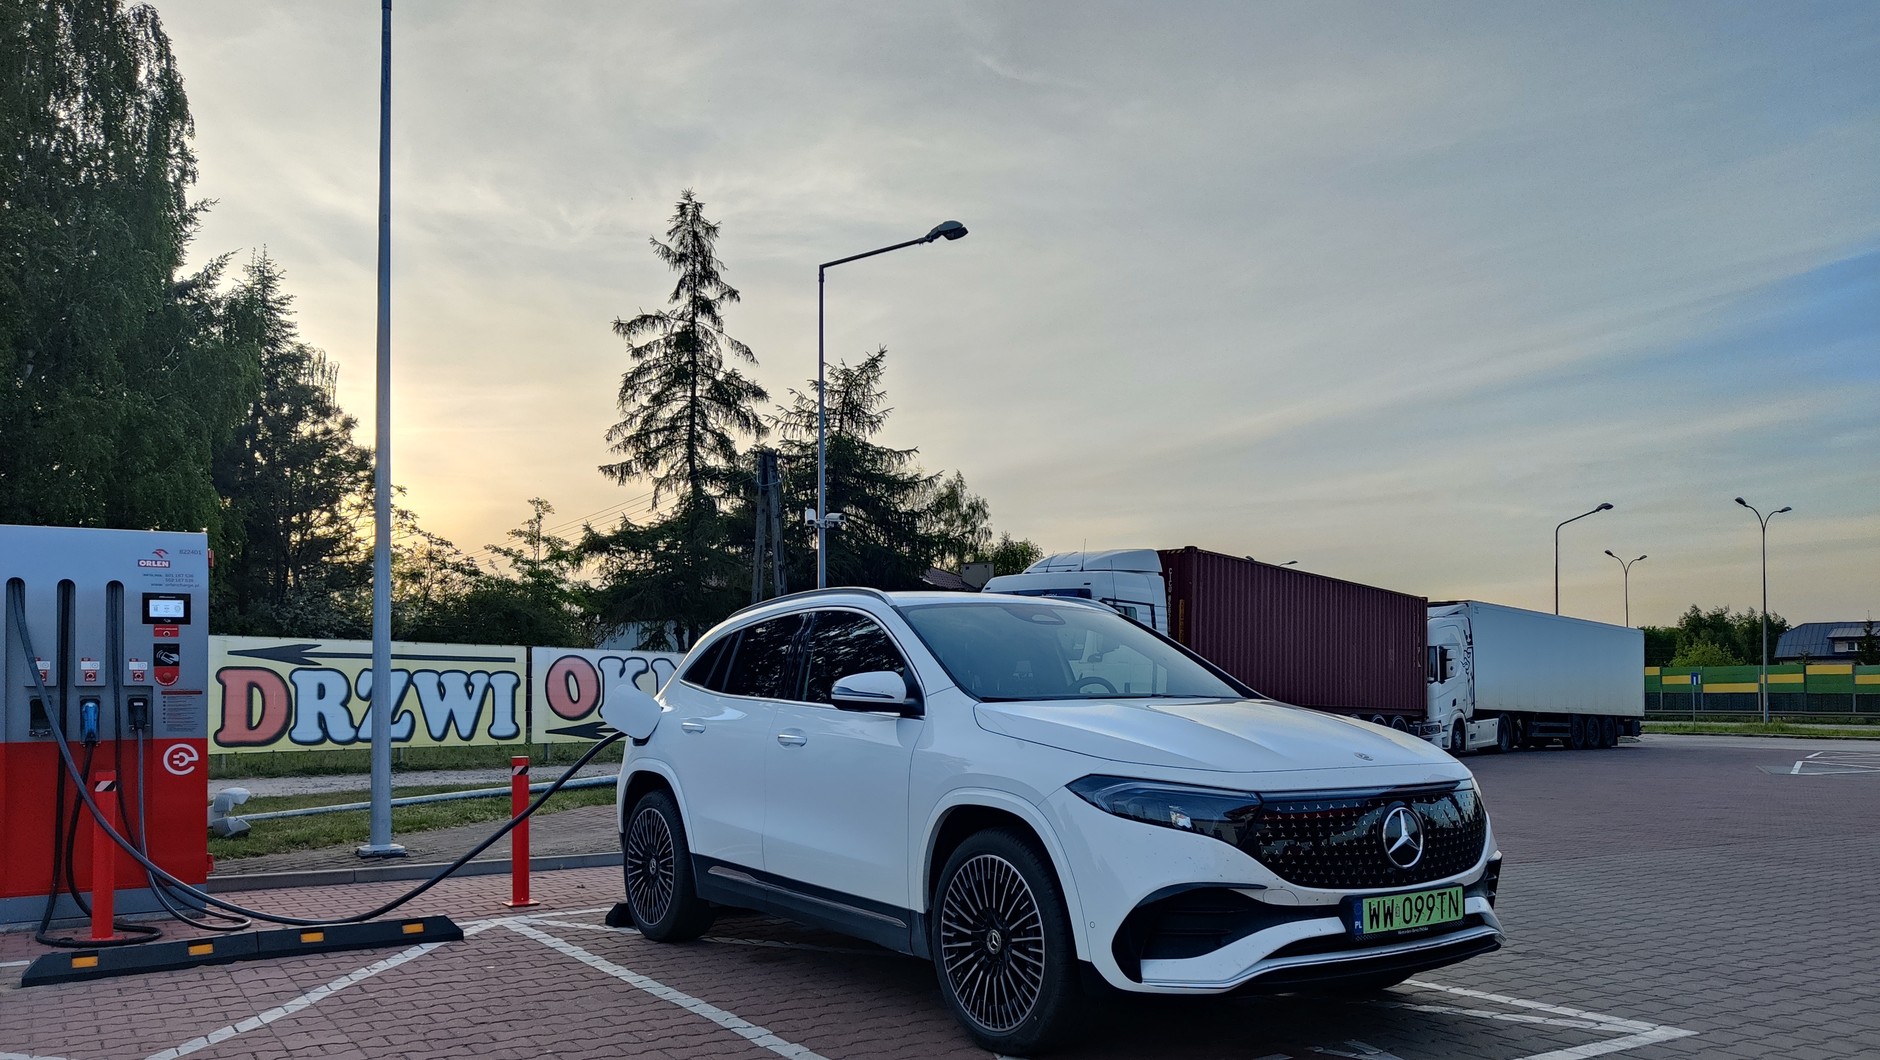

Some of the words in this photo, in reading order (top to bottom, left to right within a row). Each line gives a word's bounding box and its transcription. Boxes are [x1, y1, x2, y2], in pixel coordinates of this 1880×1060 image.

[213, 666, 521, 748] DRZWI
[1354, 921, 1363, 929] PL
[1368, 899, 1395, 930] WW
[1402, 889, 1460, 925] 099TN
